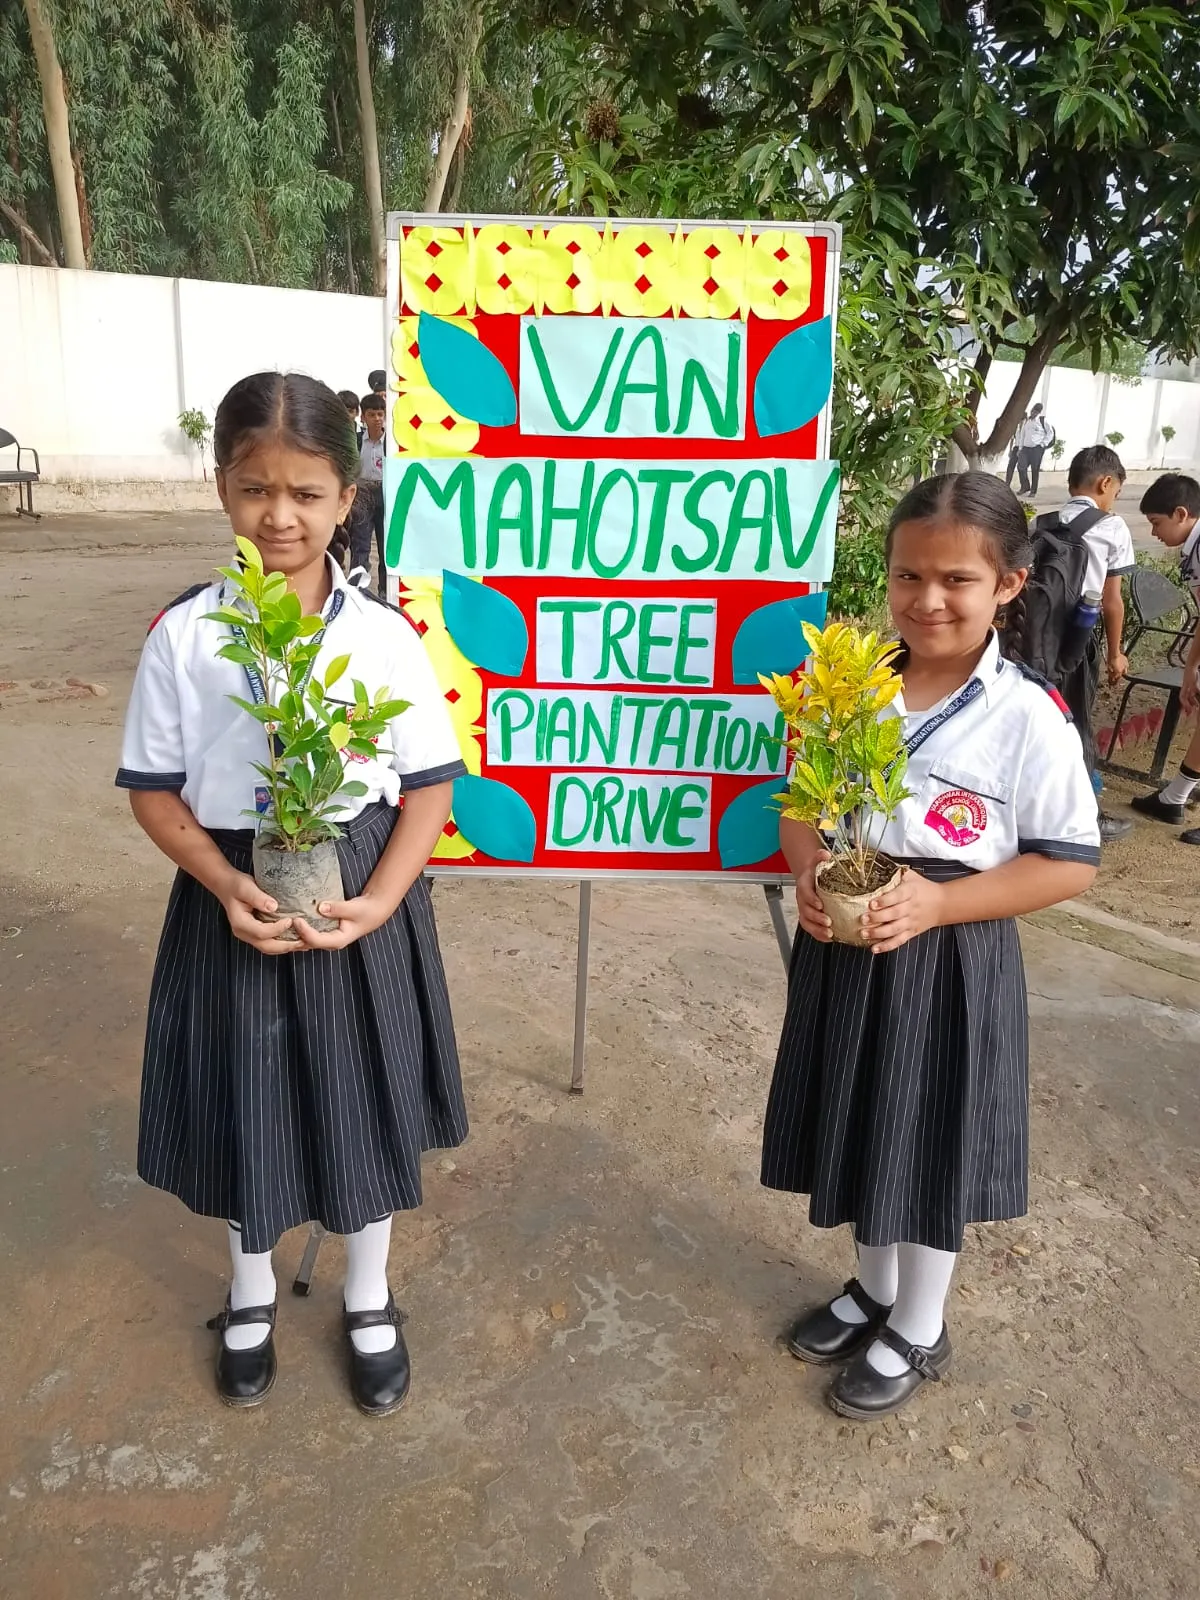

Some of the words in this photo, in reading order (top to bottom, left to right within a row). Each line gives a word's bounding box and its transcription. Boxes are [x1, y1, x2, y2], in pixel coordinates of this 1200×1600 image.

[527, 325, 741, 438] VAN
[386, 459, 841, 578] MAHOTSAV
[539, 600, 715, 684] TREE
[905, 712, 944, 755] NTERNATIONAL
[941, 697, 963, 719] PUBLIC
[959, 681, 984, 703] SCHOOL
[551, 775, 709, 847] DRIVE
